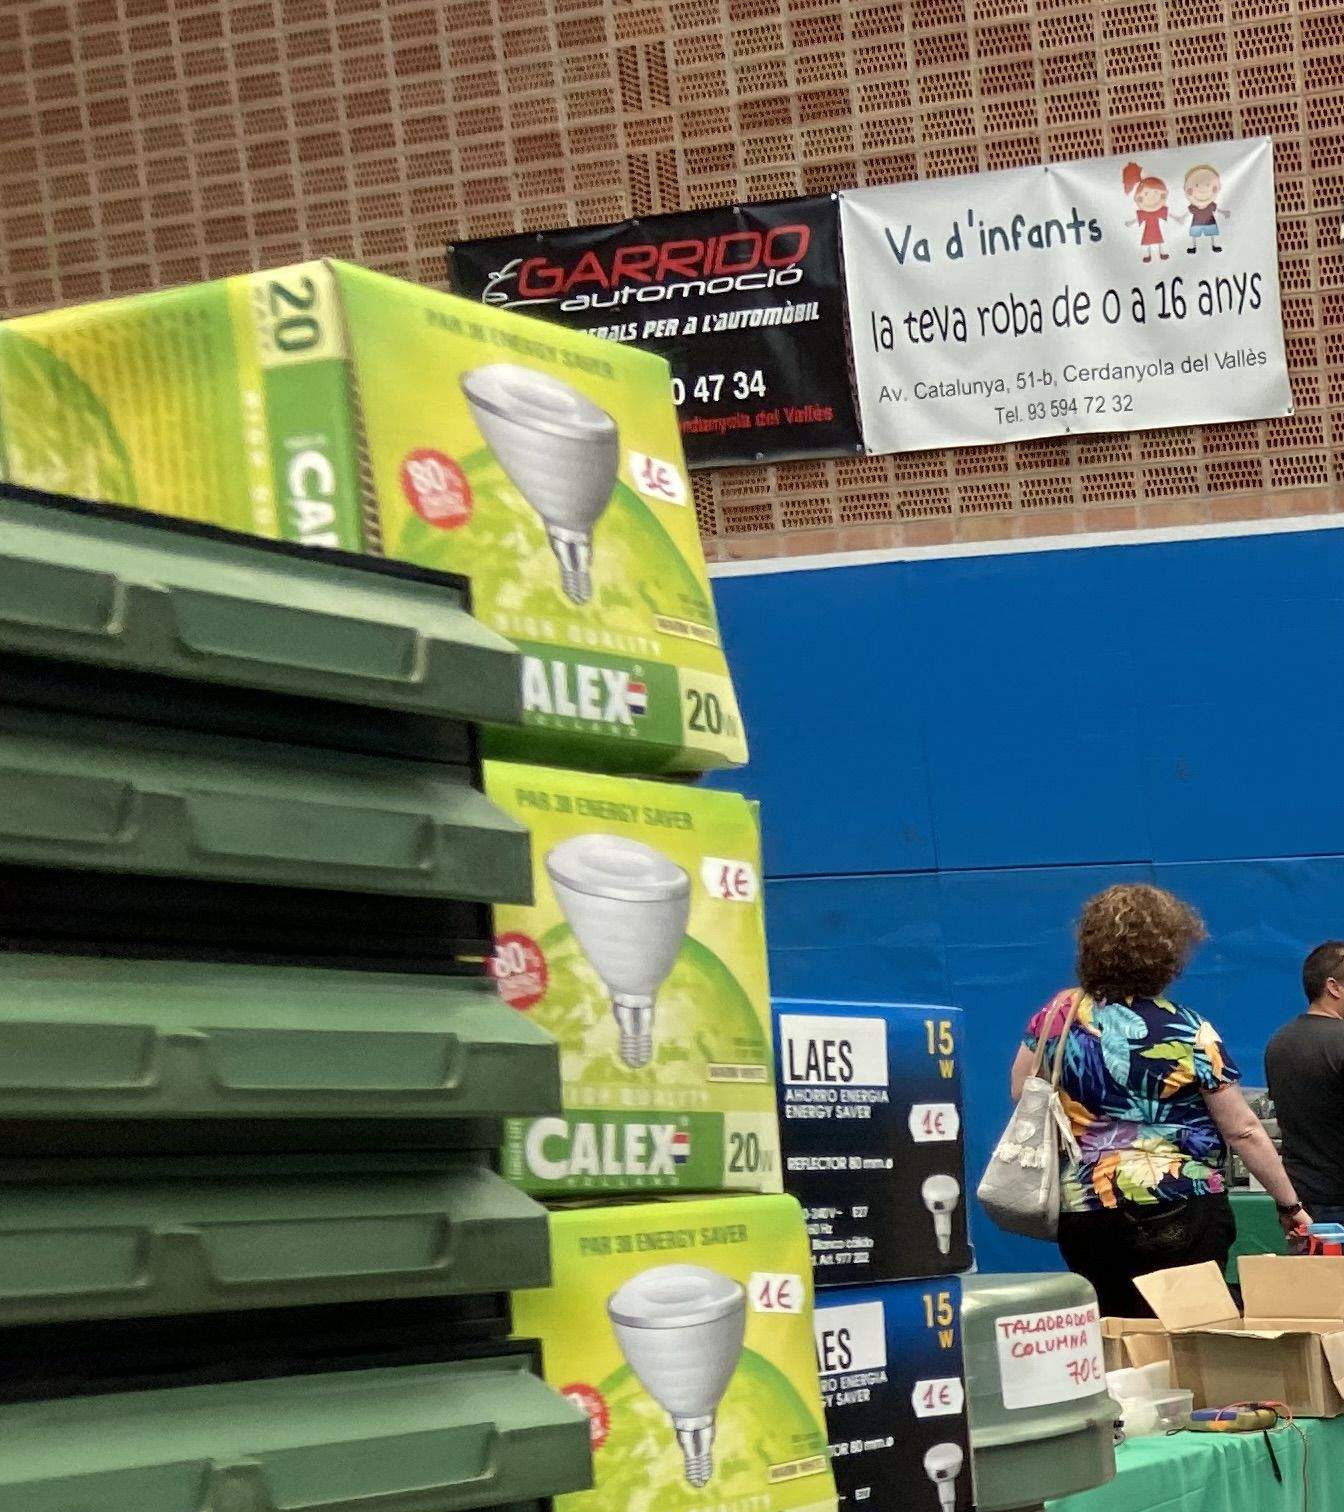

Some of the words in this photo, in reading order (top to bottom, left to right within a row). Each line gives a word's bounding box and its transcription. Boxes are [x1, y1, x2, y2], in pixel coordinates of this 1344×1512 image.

[884, 224, 931, 266] Va
[945, 207, 1103, 261] d'infants
[518, 223, 811, 297] GARRIDO
[268, 275, 321, 352] 20
[642, 316, 678, 340] PER
[682, 316, 698, 336] A
[872, 311, 894, 353] la
[903, 304, 968, 345] teva
[976, 292, 1044, 339] roba
[1052, 284, 1091, 329] de
[1131, 286, 1146, 325] a
[1154, 276, 1188, 321] 16
[1197, 271, 1263, 317] anys
[693, 374, 724, 403] 47
[733, 369, 767, 400] 34
[877, 386, 908, 404] Av.
[913, 377, 1012, 402] Catalunya,
[1063, 357, 1176, 385] Cerdanyola
[1180, 352, 1210, 375] del
[1214, 346, 1269, 371] Vallès
[994, 405, 1024, 426] Tel.
[1027, 402, 1047, 422] 93
[1050, 397, 1078, 418] 594
[1083, 395, 1106, 414] 72
[1111, 393, 1135, 413] 32
[521, 655, 634, 726] ALEX
[686, 688, 723, 735] 20
[925, 1019, 955, 1056] 15
[787, 1038, 854, 1082] LAES
[938, 1059, 955, 1080] W
[524, 1117, 677, 1180] CALEX
[728, 1131, 760, 1174] 20
[922, 1292, 954, 1330] 15
[937, 1328, 956, 1350] W
[1011, 1329, 1089, 1359] COLUMNA
[922, 1383, 951, 1409] 1€
